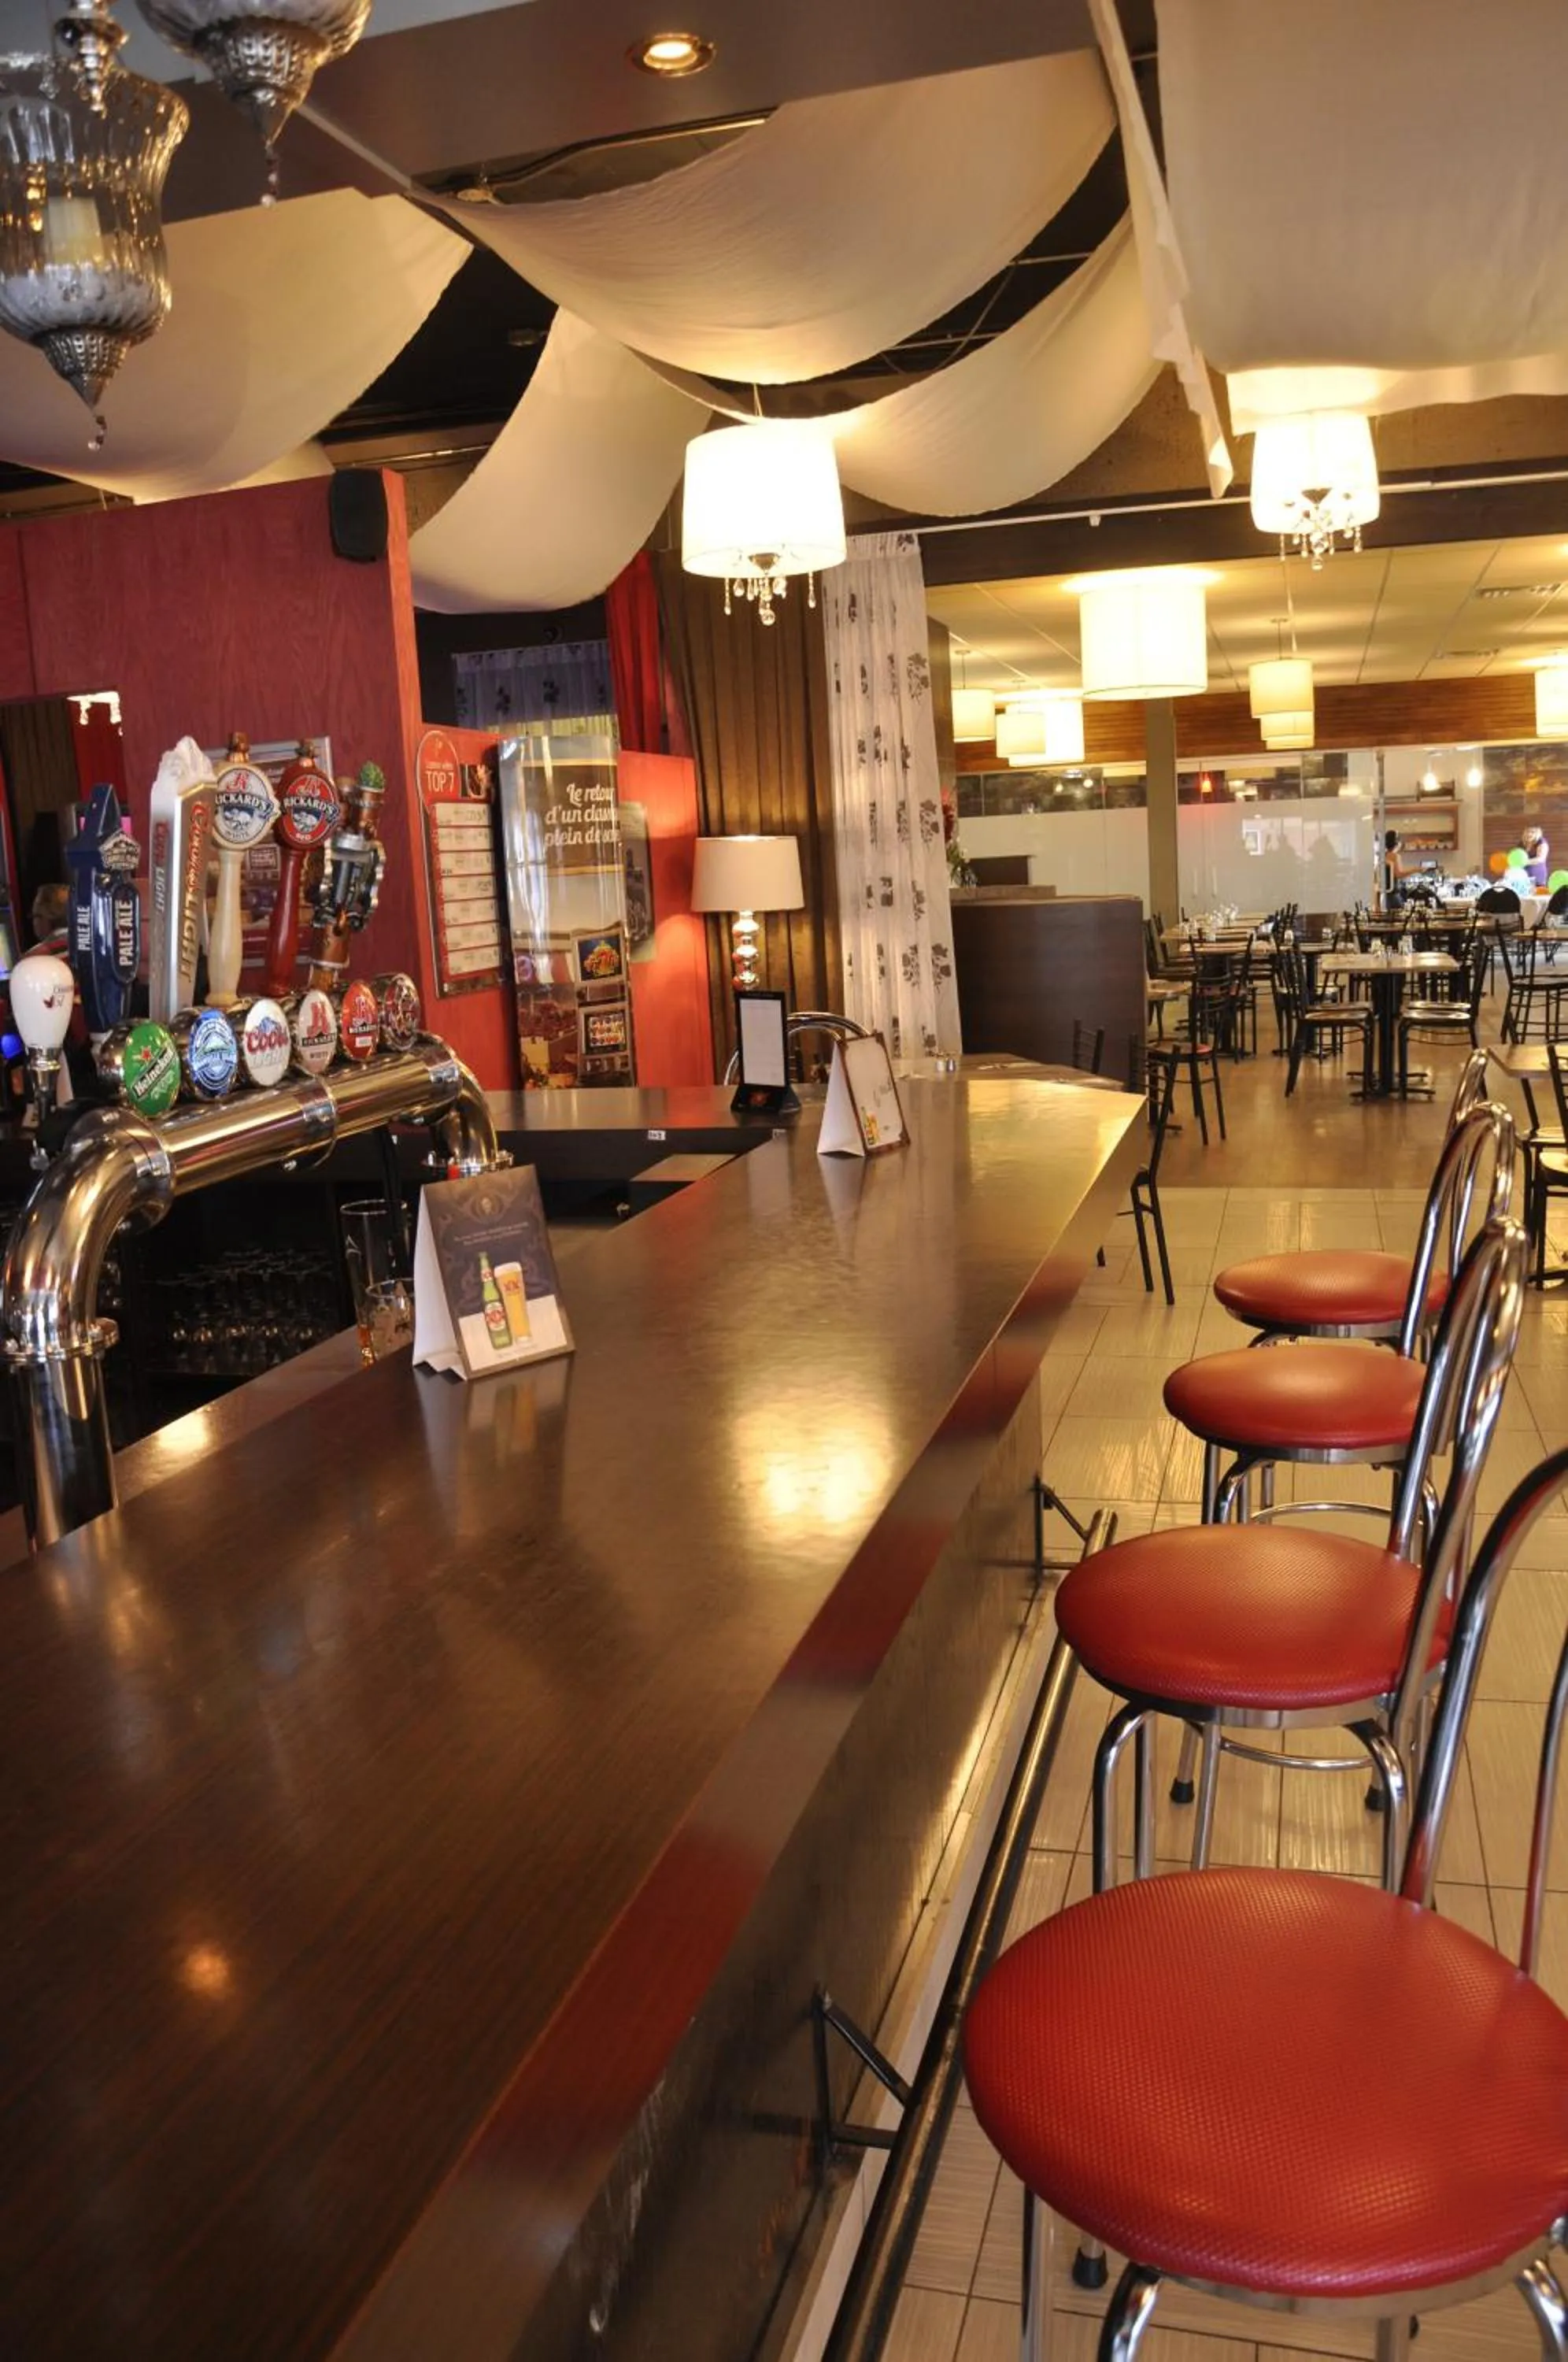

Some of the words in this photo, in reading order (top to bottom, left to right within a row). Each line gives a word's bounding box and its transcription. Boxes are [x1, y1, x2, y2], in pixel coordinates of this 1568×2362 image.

[426, 771, 446, 792] TOP
[448, 772, 454, 793] 7
[566, 783, 582, 808] Le
[545, 805, 582, 824] d'un
[545, 827, 583, 847] plein
[156, 866, 166, 913] LIGHT
[76, 906, 90, 925] ALE
[118, 899, 133, 927] ALE
[77, 927, 91, 951] PALE
[119, 929, 134, 967] PALE
[180, 890, 198, 983] LIGHT
